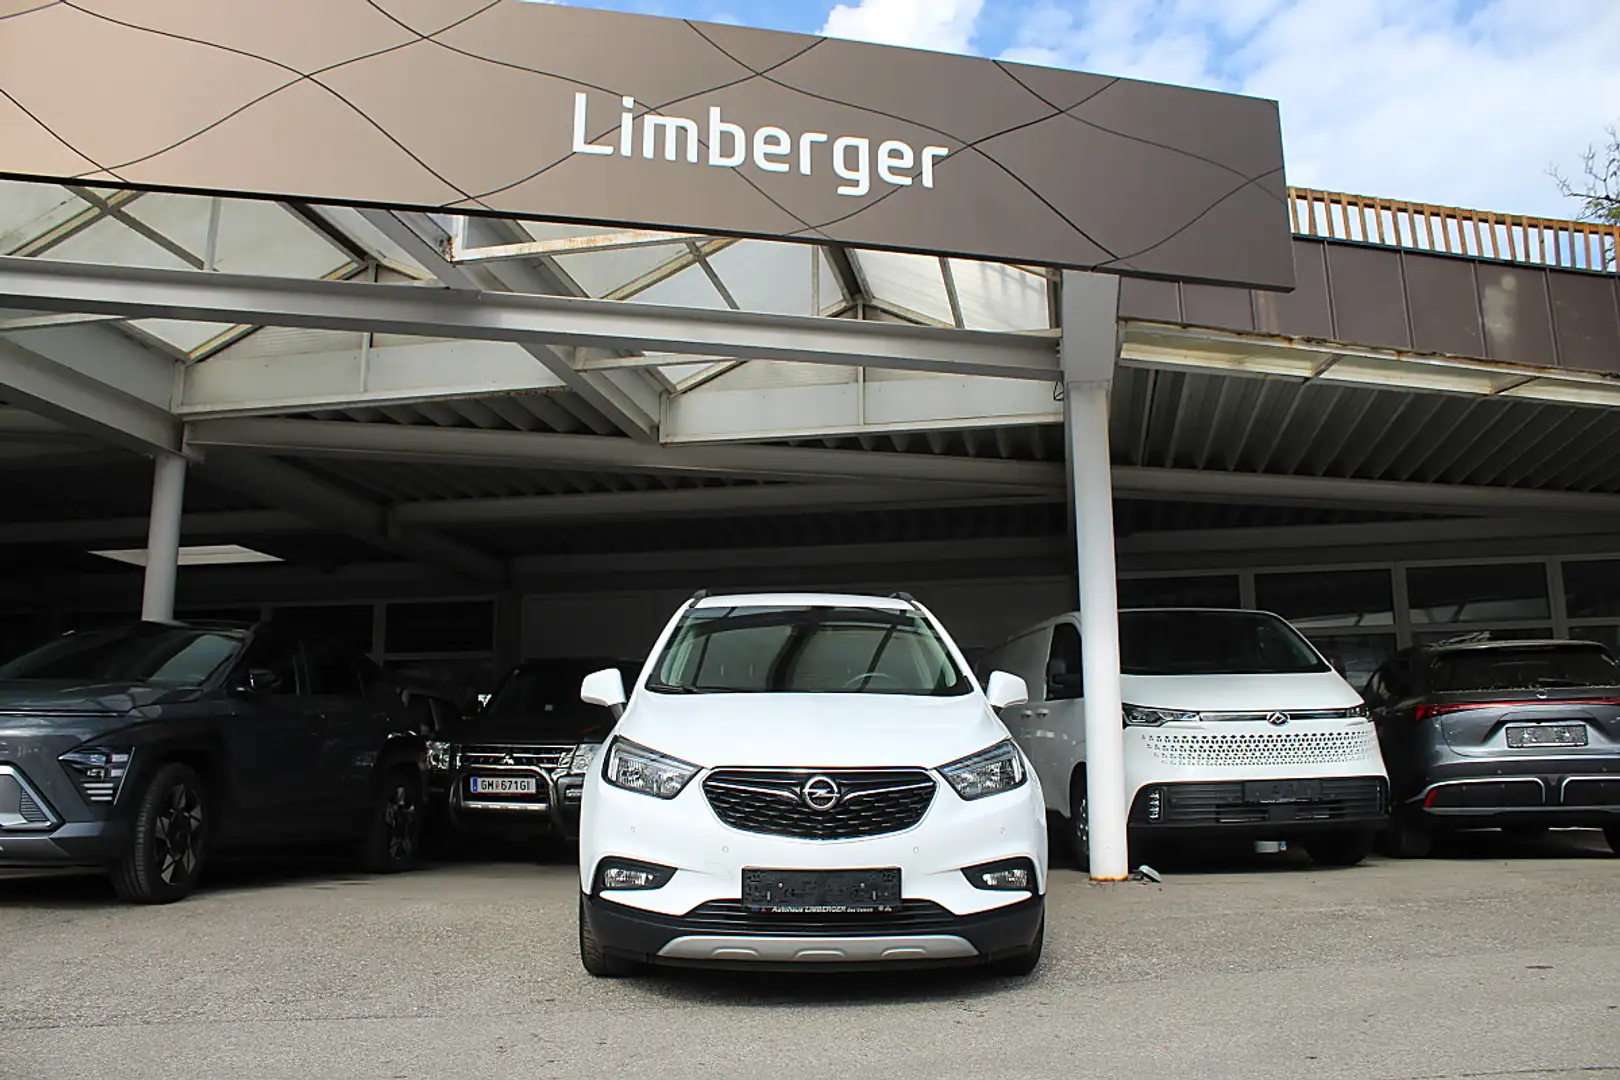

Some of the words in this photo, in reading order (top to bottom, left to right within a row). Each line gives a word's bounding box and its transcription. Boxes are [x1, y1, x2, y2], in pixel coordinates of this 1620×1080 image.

[572, 91, 949, 196] Limberger
[771, 905, 803, 913] Autohaus
[804, 905, 847, 913] LIMBERGER
